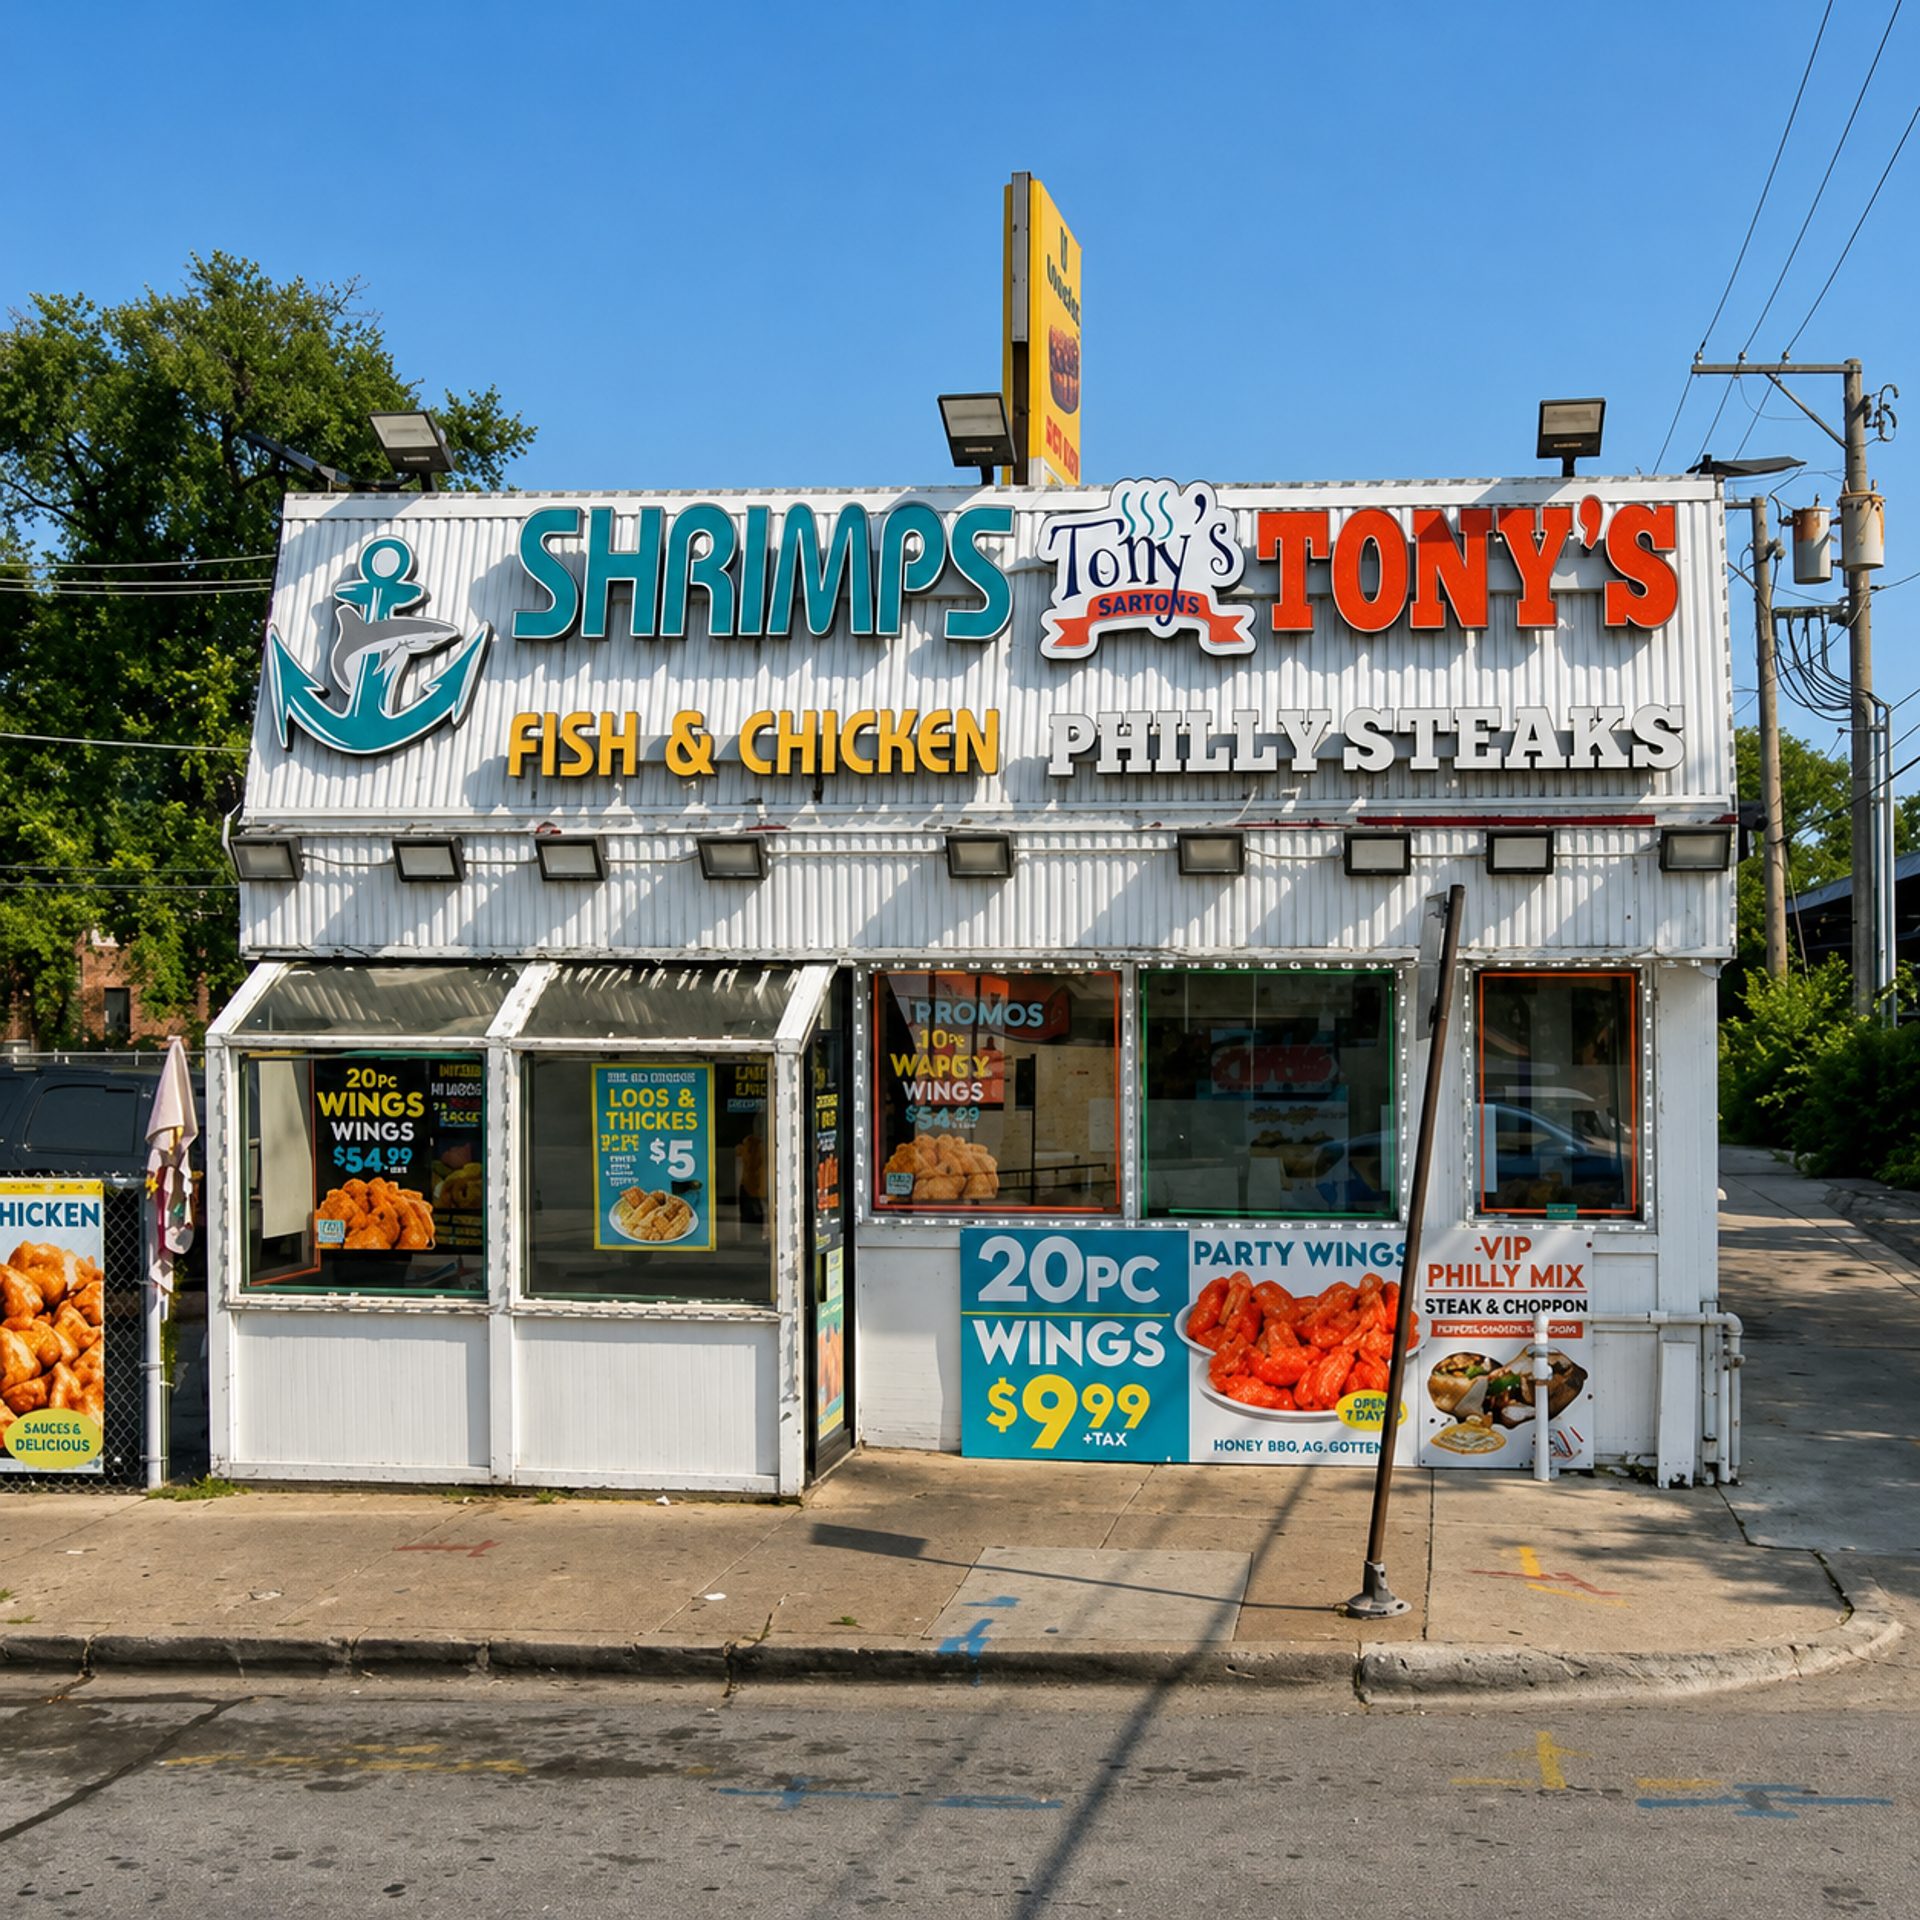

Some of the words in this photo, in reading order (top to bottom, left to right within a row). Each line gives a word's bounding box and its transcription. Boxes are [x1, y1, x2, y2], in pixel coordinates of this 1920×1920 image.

[512, 502, 1015, 641] SHRIMPS
[1048, 493, 1235, 627] Tony's
[1256, 495, 1679, 633] TONY'S
[1098, 593, 1200, 616] SARTONS
[508, 710, 640, 777] FISH
[665, 710, 716, 776] &
[739, 708, 1000, 775] CHICKEN
[1048, 707, 1332, 776] PHILLY
[1343, 705, 1687, 772] STEAKS
[346, 1068, 397, 1088] 20PC
[609, 1088, 669, 1108] LOOS
[678, 1088, 696, 1108] &
[902, 1081, 984, 1102] WINGS
[316, 1091, 425, 1118] WINGS
[331, 1121, 414, 1141] WINGS
[606, 1111, 698, 1130] THICKES
[649, 1137, 696, 1179] $5
[0, 1202, 100, 1227] HICKEN
[1194, 1241, 1295, 1266] PARTY
[1428, 1264, 1521, 1287] PHILLY
[1531, 1264, 1585, 1288] MIX
[1425, 1298, 1482, 1314] STEAK
[1486, 1298, 1499, 1314] &
[1503, 1299, 1588, 1314] CHOPPON
[972, 1320, 1165, 1367] WINGS
[24, 1423, 70, 1434] SAUCES
[15, 1438, 90, 1452] DELICIOUS
[1214, 1439, 1263, 1452] HONEY
